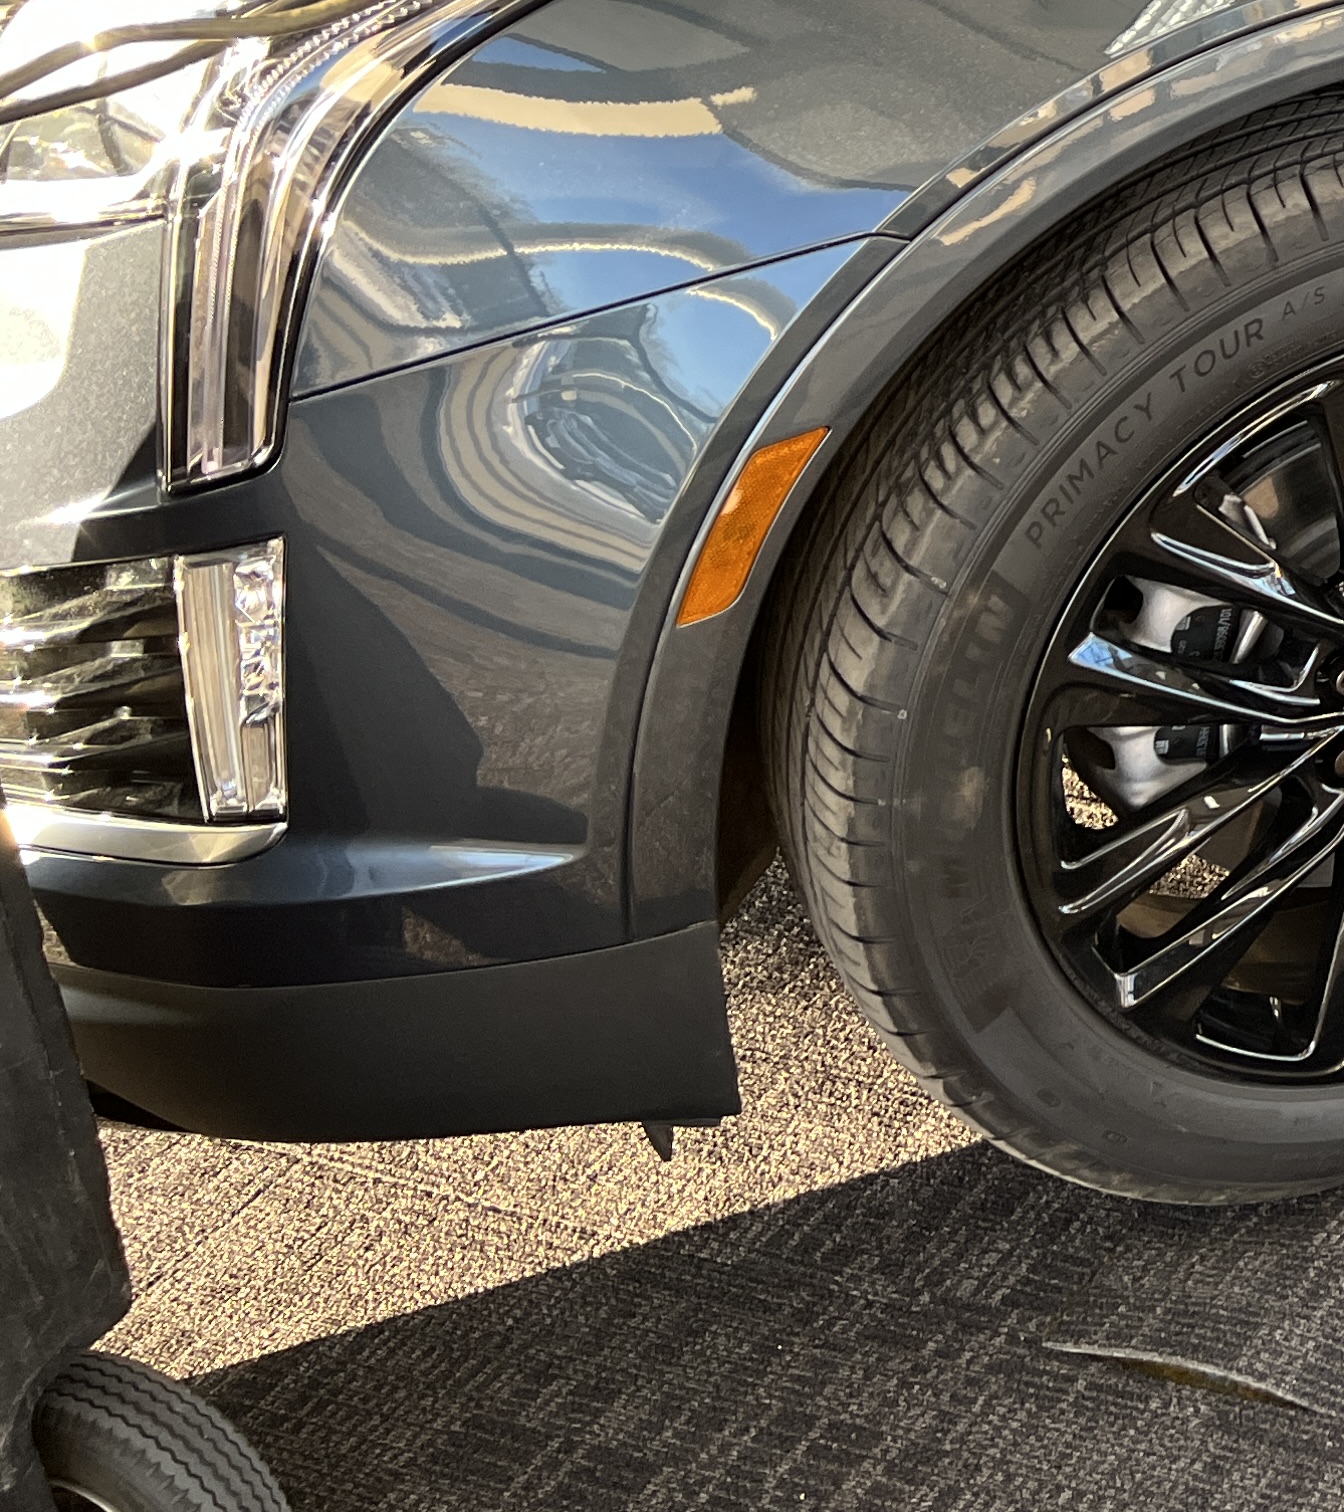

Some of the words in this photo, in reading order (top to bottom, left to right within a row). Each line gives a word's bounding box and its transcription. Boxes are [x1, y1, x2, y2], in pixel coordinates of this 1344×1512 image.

[1025, 398, 1158, 550] PRIMACY
[1168, 318, 1264, 393] TOUR
[1281, 285, 1326, 322] A/S
